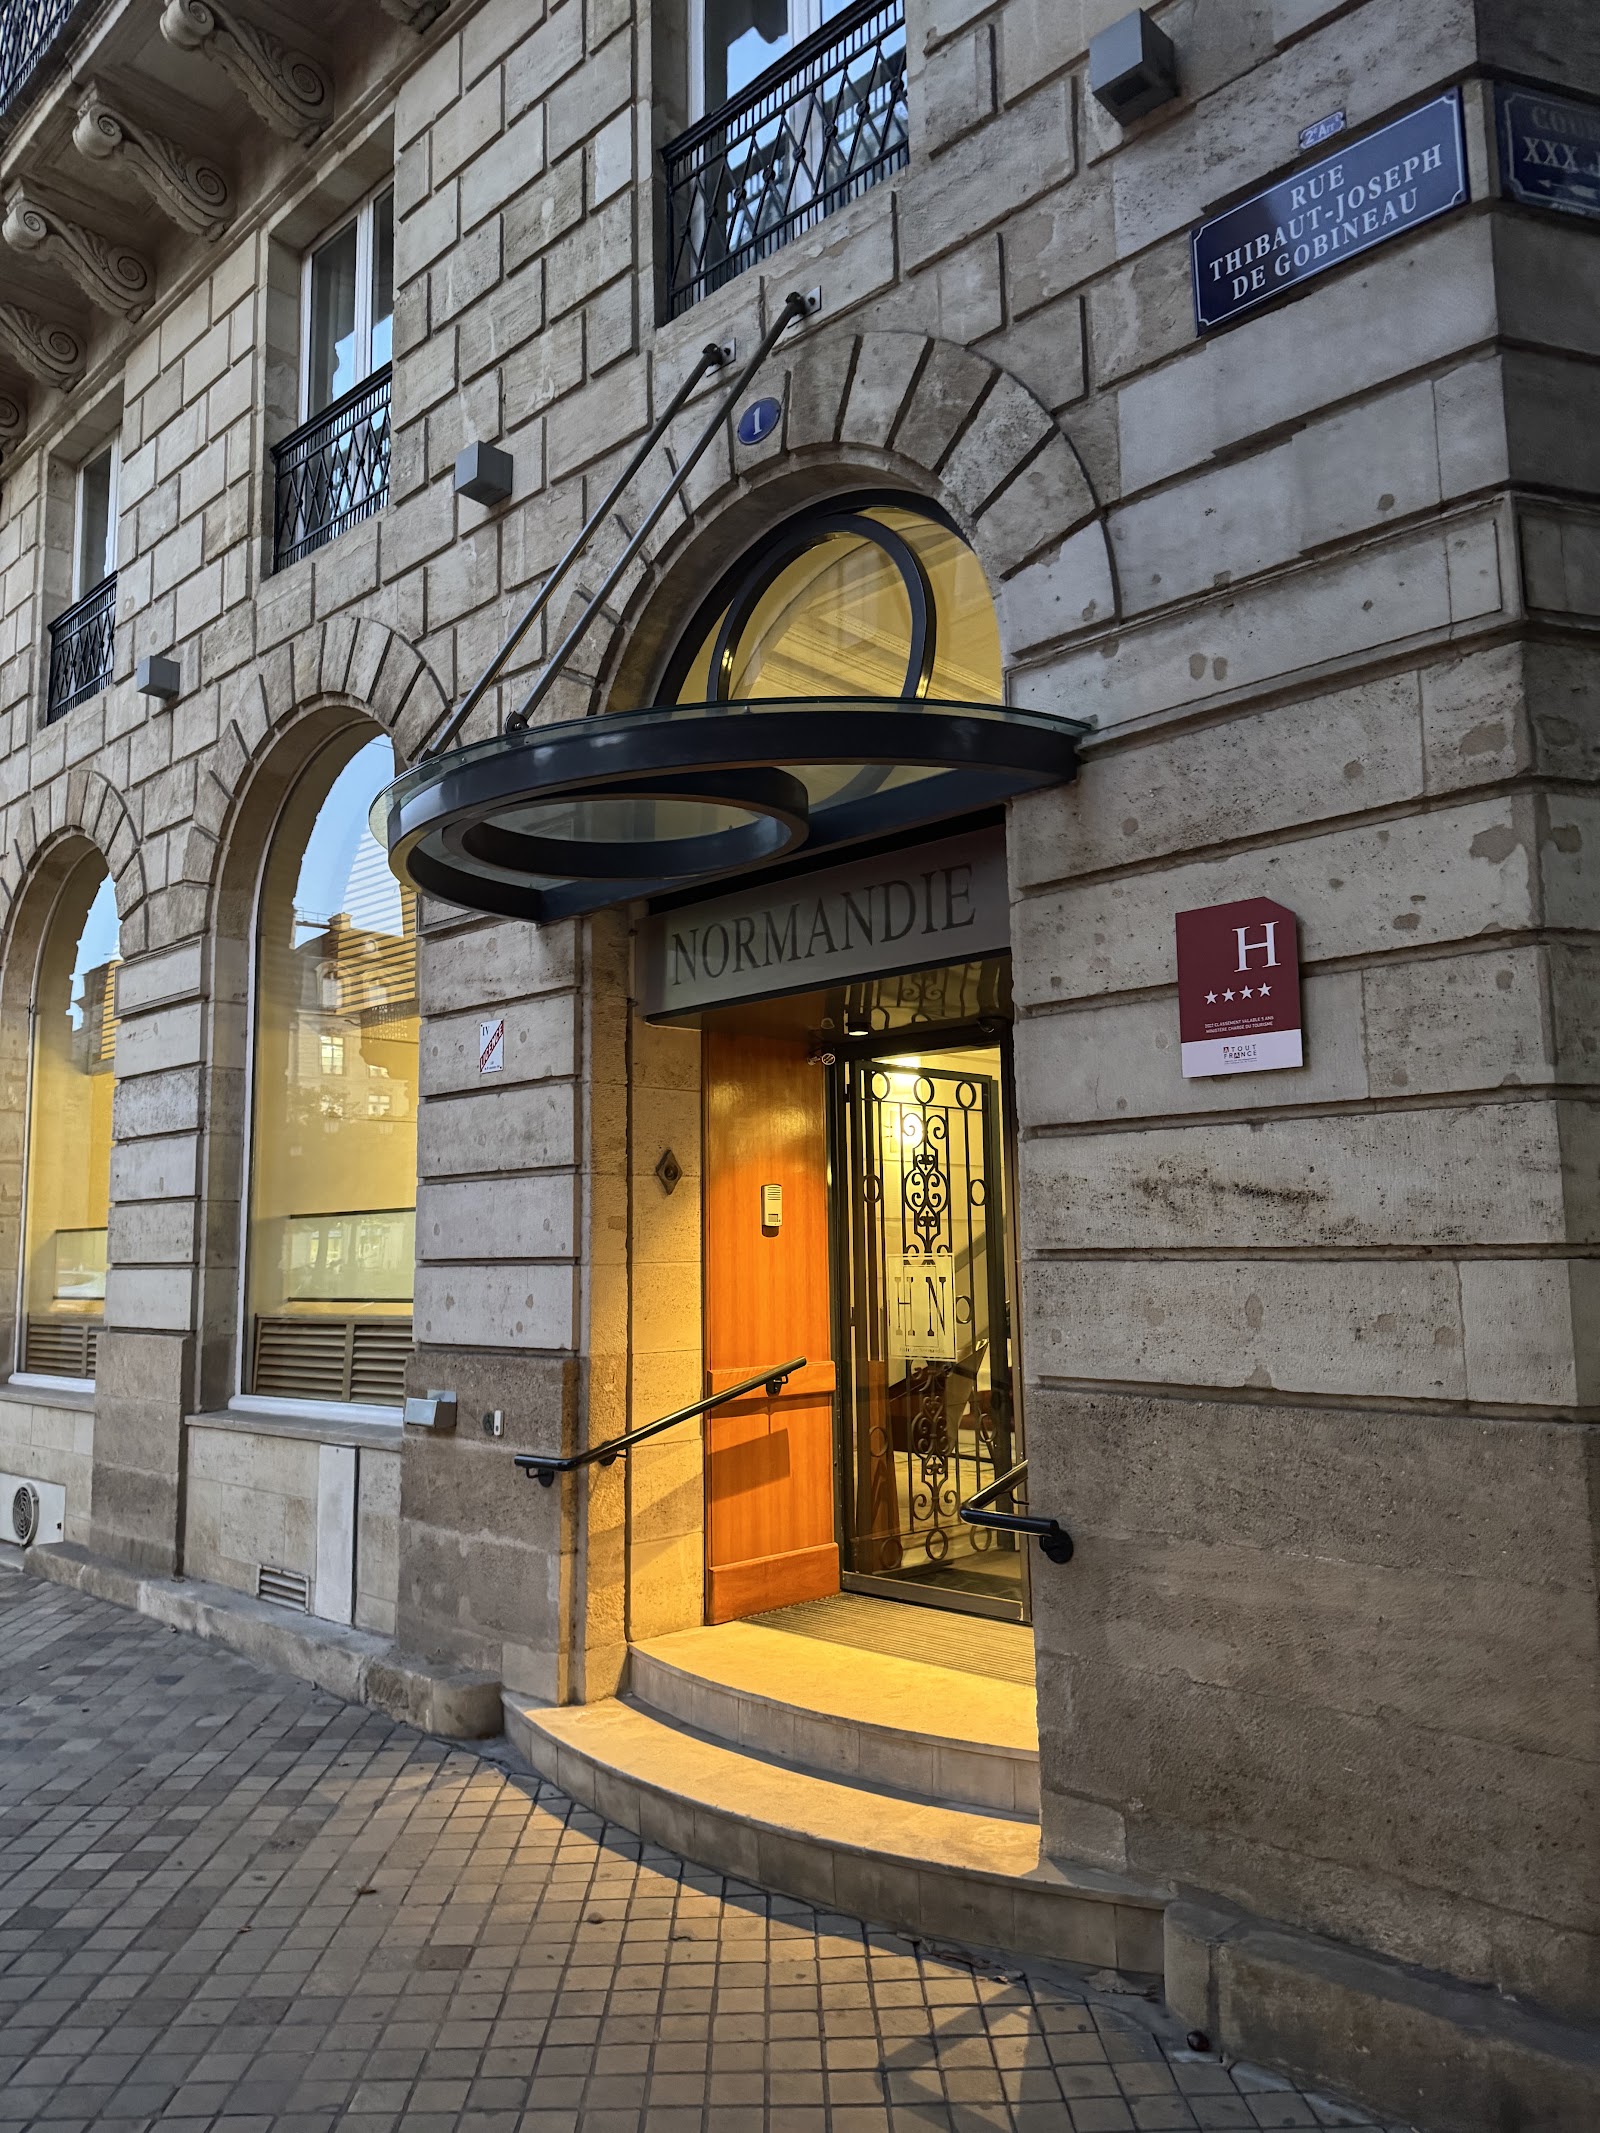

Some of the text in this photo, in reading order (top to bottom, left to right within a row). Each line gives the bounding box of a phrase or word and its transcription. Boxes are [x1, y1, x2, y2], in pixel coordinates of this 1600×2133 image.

[1522, 136, 1580, 173] XXX
[1209, 144, 1442, 281] THIBAUT-JOSEPH
[1291, 165, 1345, 211] RUE
[1232, 187, 1418, 300] DE GOBINEAU
[753, 407, 762, 435] 1
[671, 863, 976, 986] NORMANDIE
[1232, 921, 1281, 973] H
